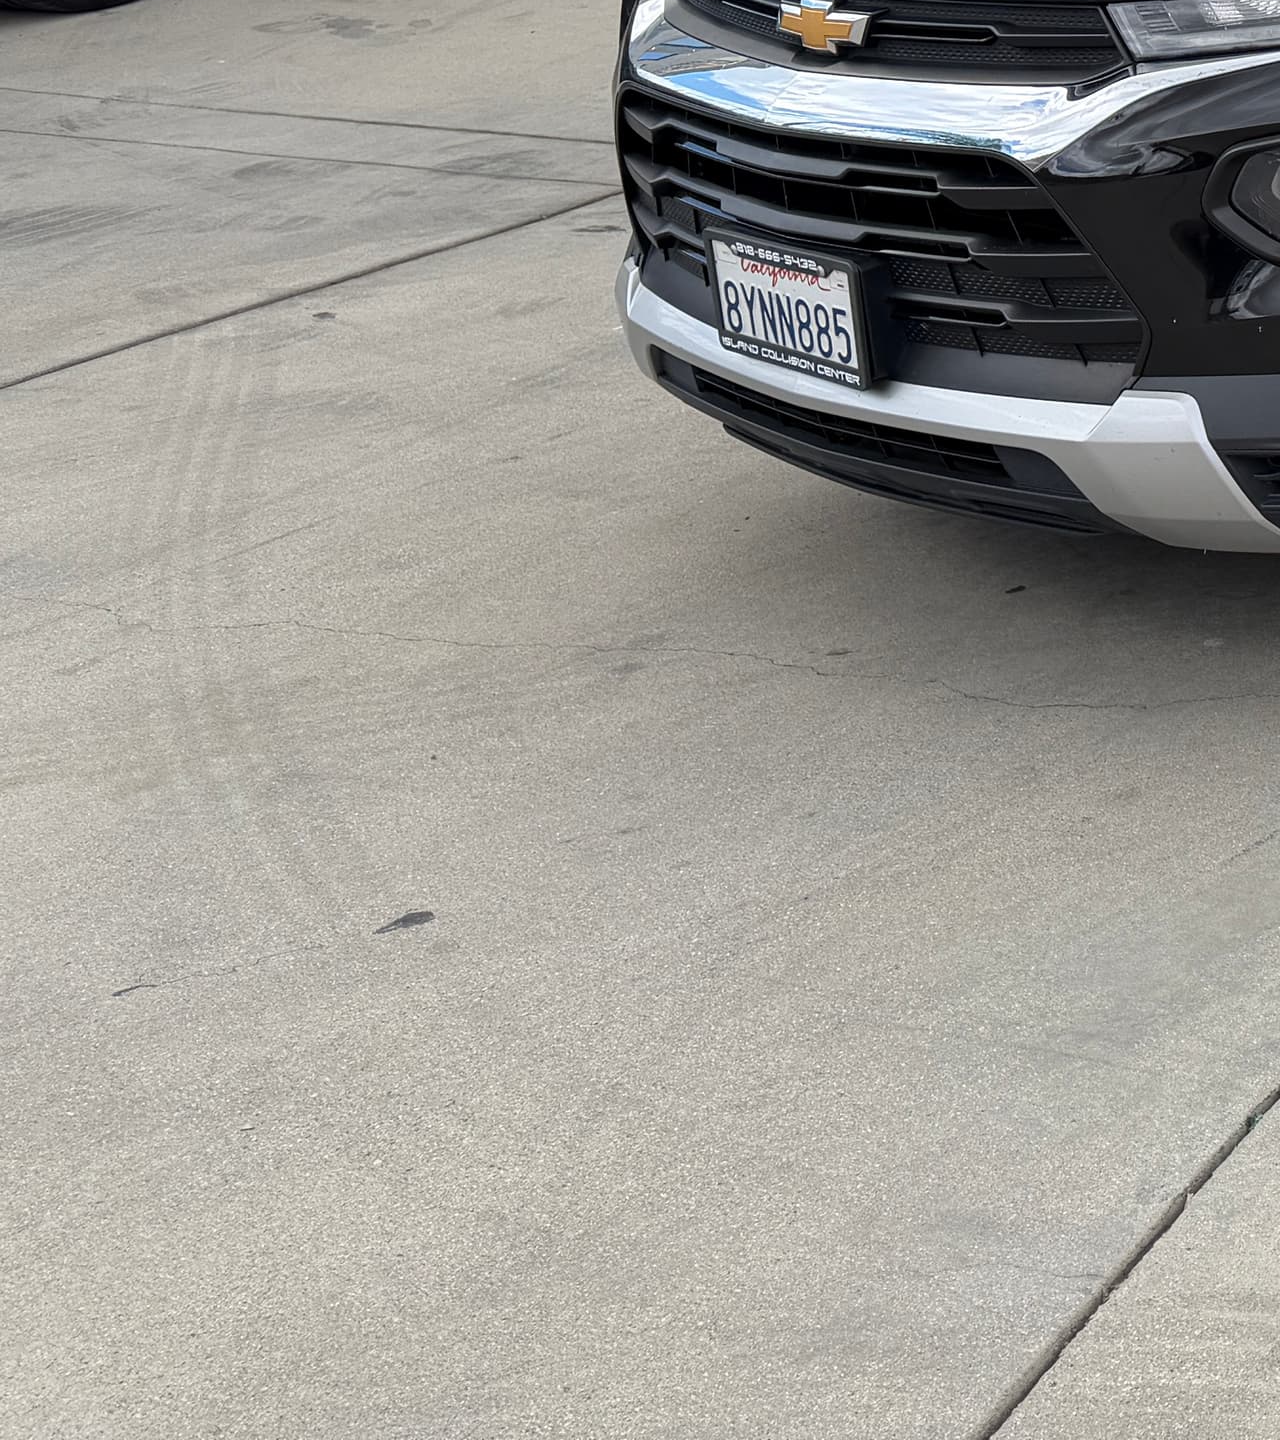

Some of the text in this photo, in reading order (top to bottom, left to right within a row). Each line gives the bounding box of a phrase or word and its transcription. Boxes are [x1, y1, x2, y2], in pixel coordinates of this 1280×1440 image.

[735, 242, 819, 272] 818-666-5432
[724, 280, 852, 364] 8YNN885
[721, 336, 860, 386] ISLAND COLLISION CENTER
